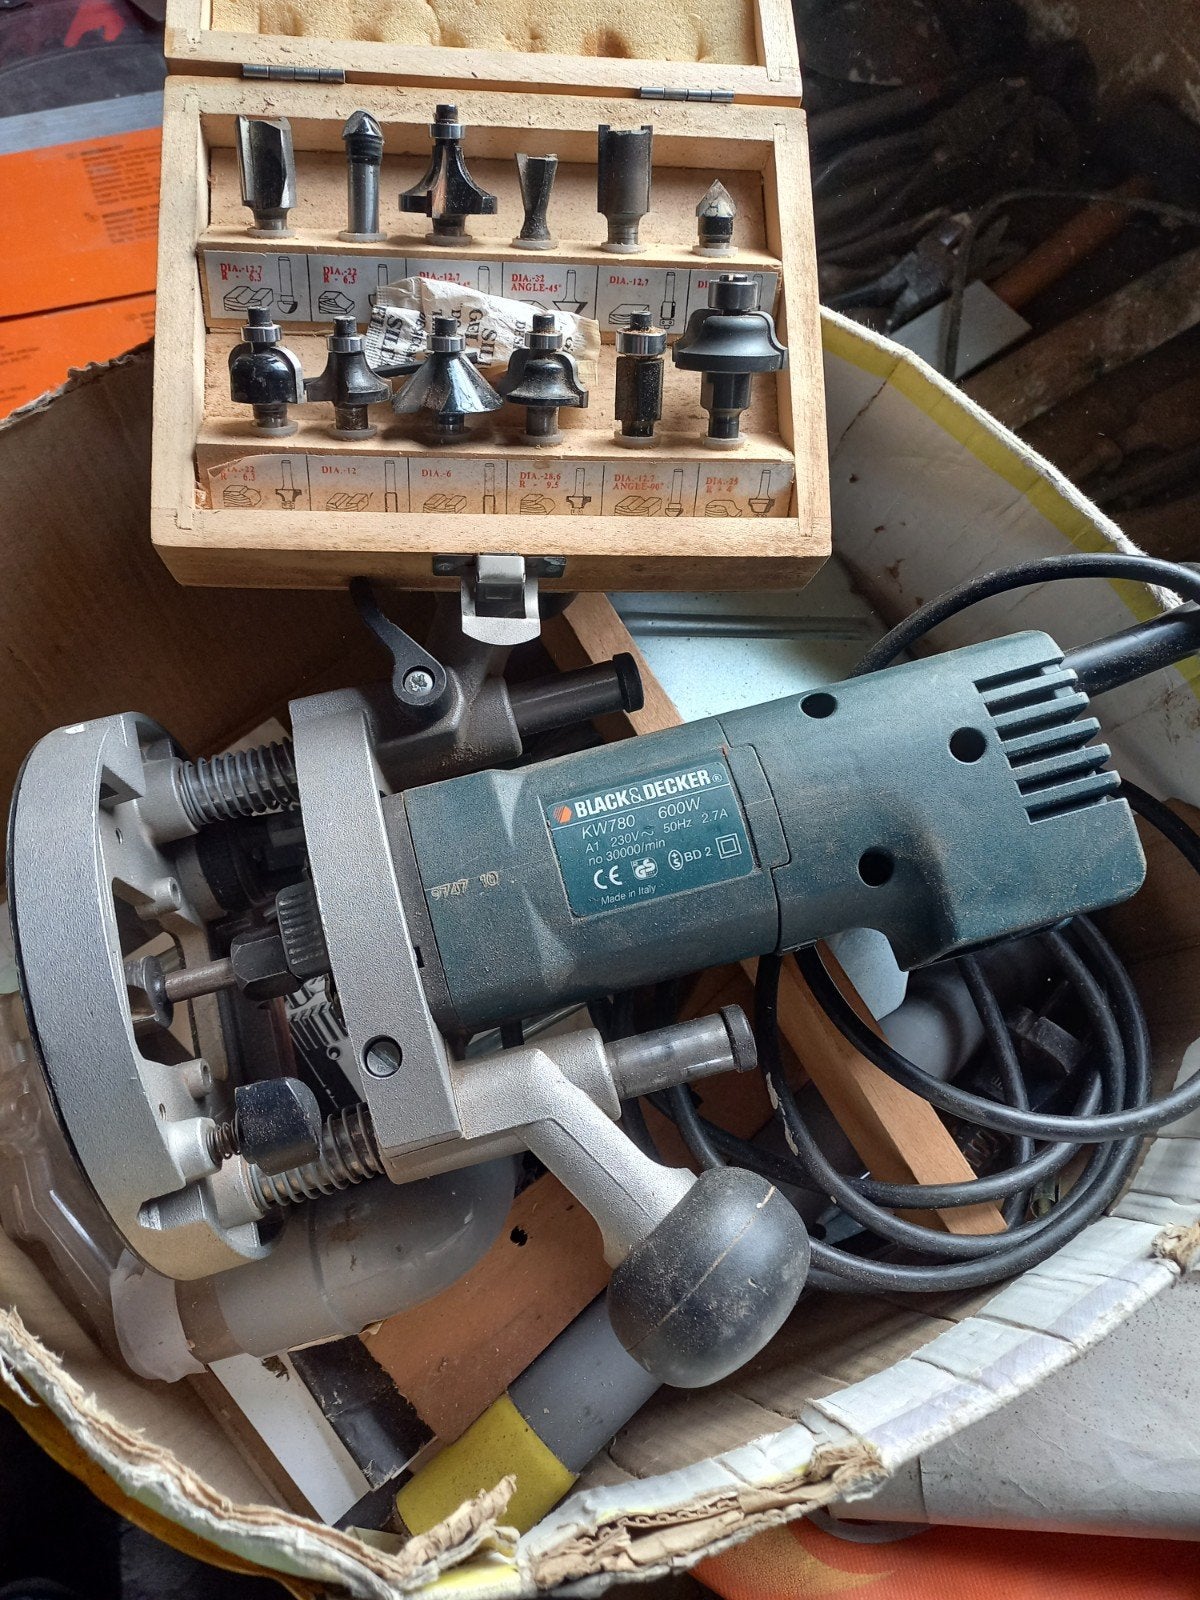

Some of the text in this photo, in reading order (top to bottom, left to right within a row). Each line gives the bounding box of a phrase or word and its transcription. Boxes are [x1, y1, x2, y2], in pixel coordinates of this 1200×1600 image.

[323, 266, 357, 275] DIA.-22
[511, 273, 545, 282] DIA.-32
[421, 469, 452, 477] DIA.-6
[582, 797, 701, 839] KW780 600W
[585, 841, 599, 854] A1
[663, 818, 692, 834] 50Hz
[701, 808, 728, 824] 2.7A
[606, 838, 666, 861] 30000/min
[684, 849, 702, 862] BD
[704, 846, 713, 857] 2
[594, 865, 622, 889] CE
[601, 884, 657, 905] Made in Italy
